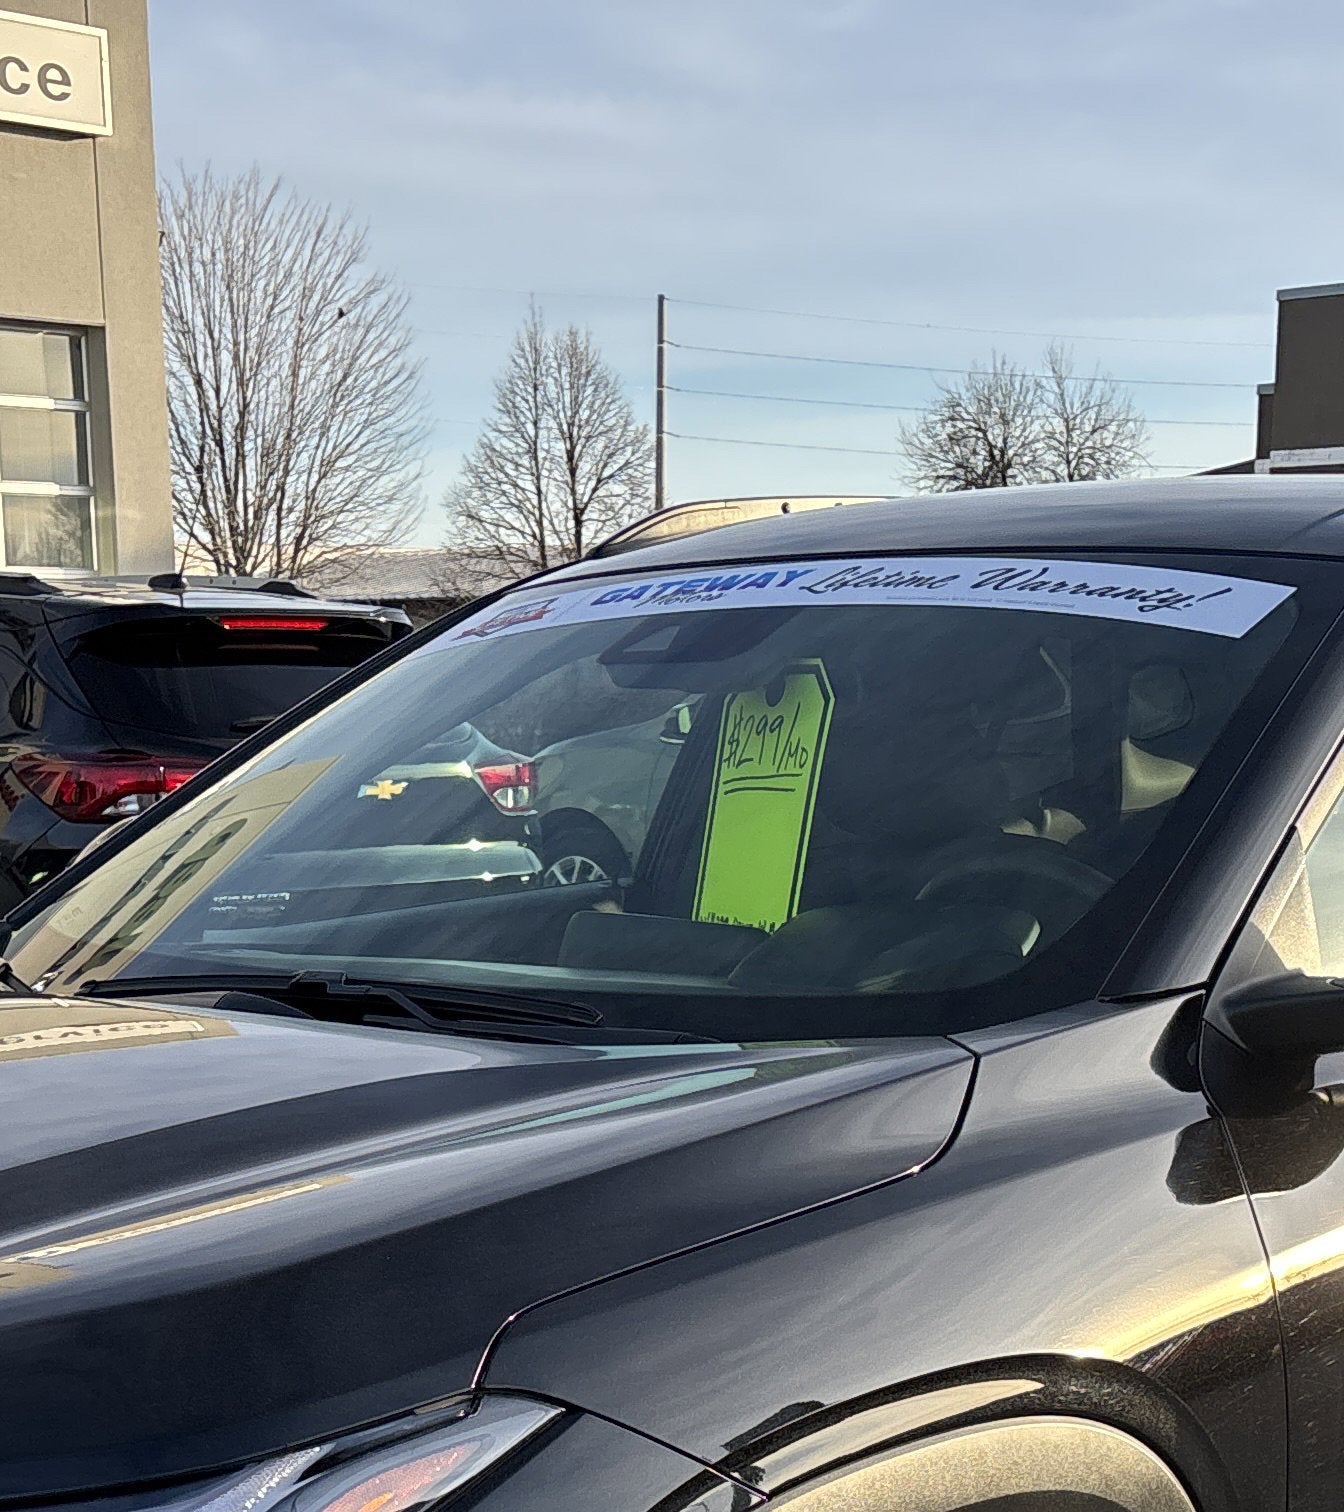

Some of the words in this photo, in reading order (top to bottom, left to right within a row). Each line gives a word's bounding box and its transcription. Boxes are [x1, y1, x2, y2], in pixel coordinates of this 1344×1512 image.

[590, 568, 818, 607] GATEWAY
[798, 565, 960, 594] Lifetime
[969, 567, 1233, 613] Warranty!
